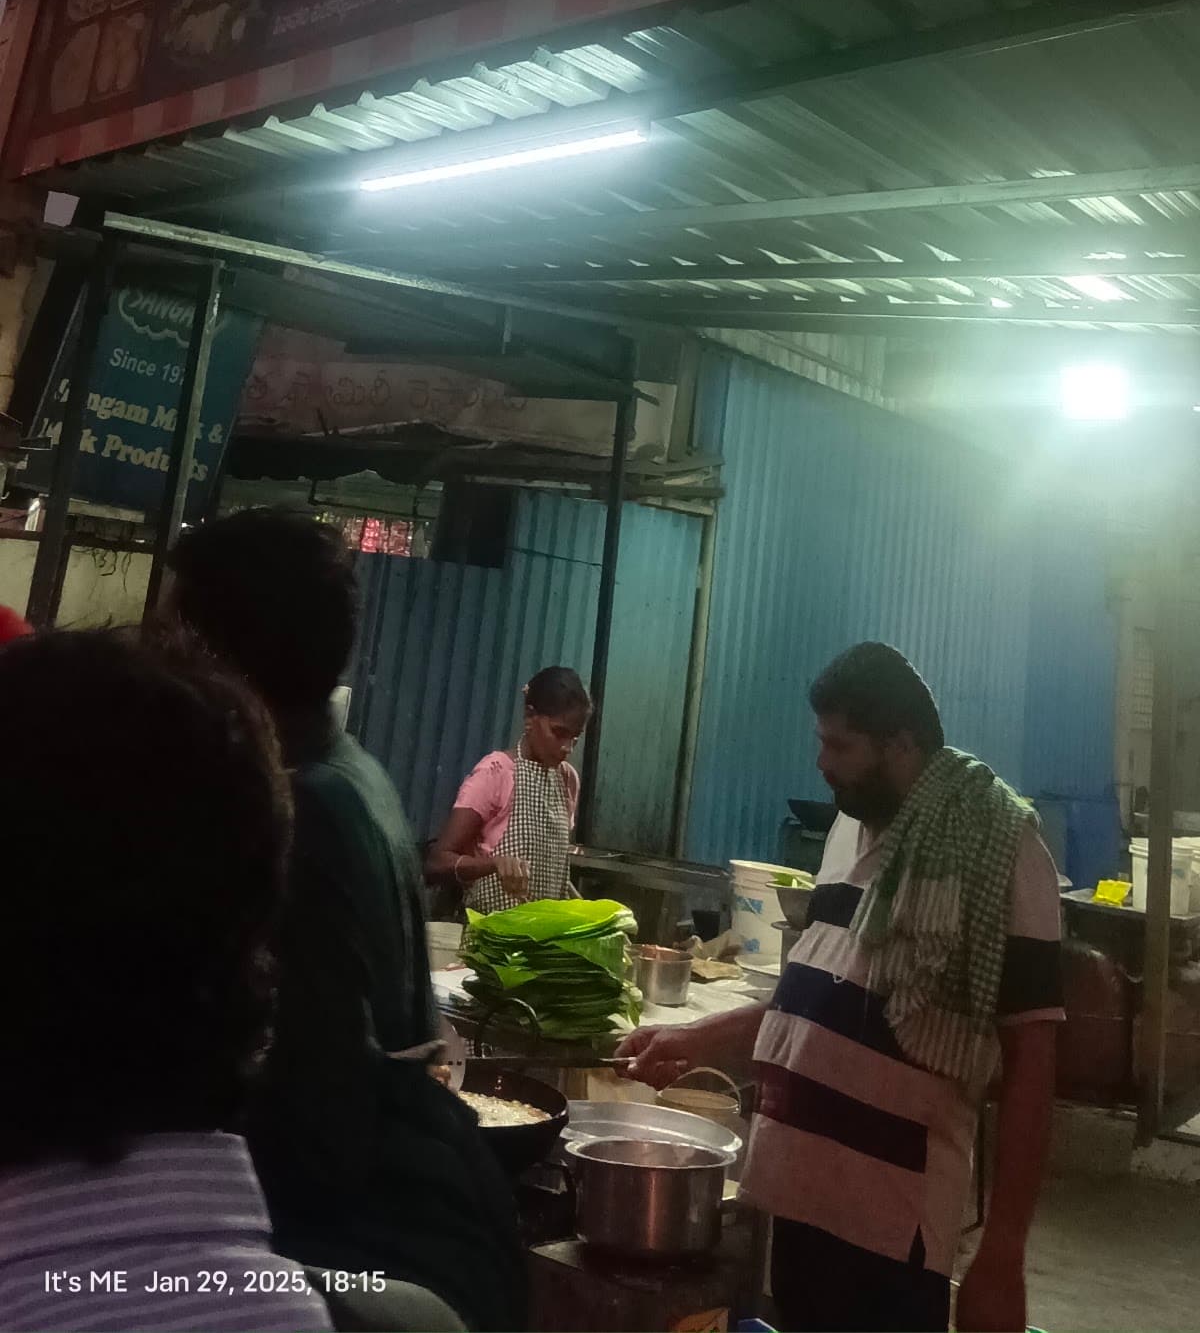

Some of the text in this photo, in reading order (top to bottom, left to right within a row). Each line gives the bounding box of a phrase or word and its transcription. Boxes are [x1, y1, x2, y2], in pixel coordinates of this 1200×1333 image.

[109, 348, 157, 377] Since
[54, 378, 150, 426] Sngam
[207, 423, 224, 445] &
